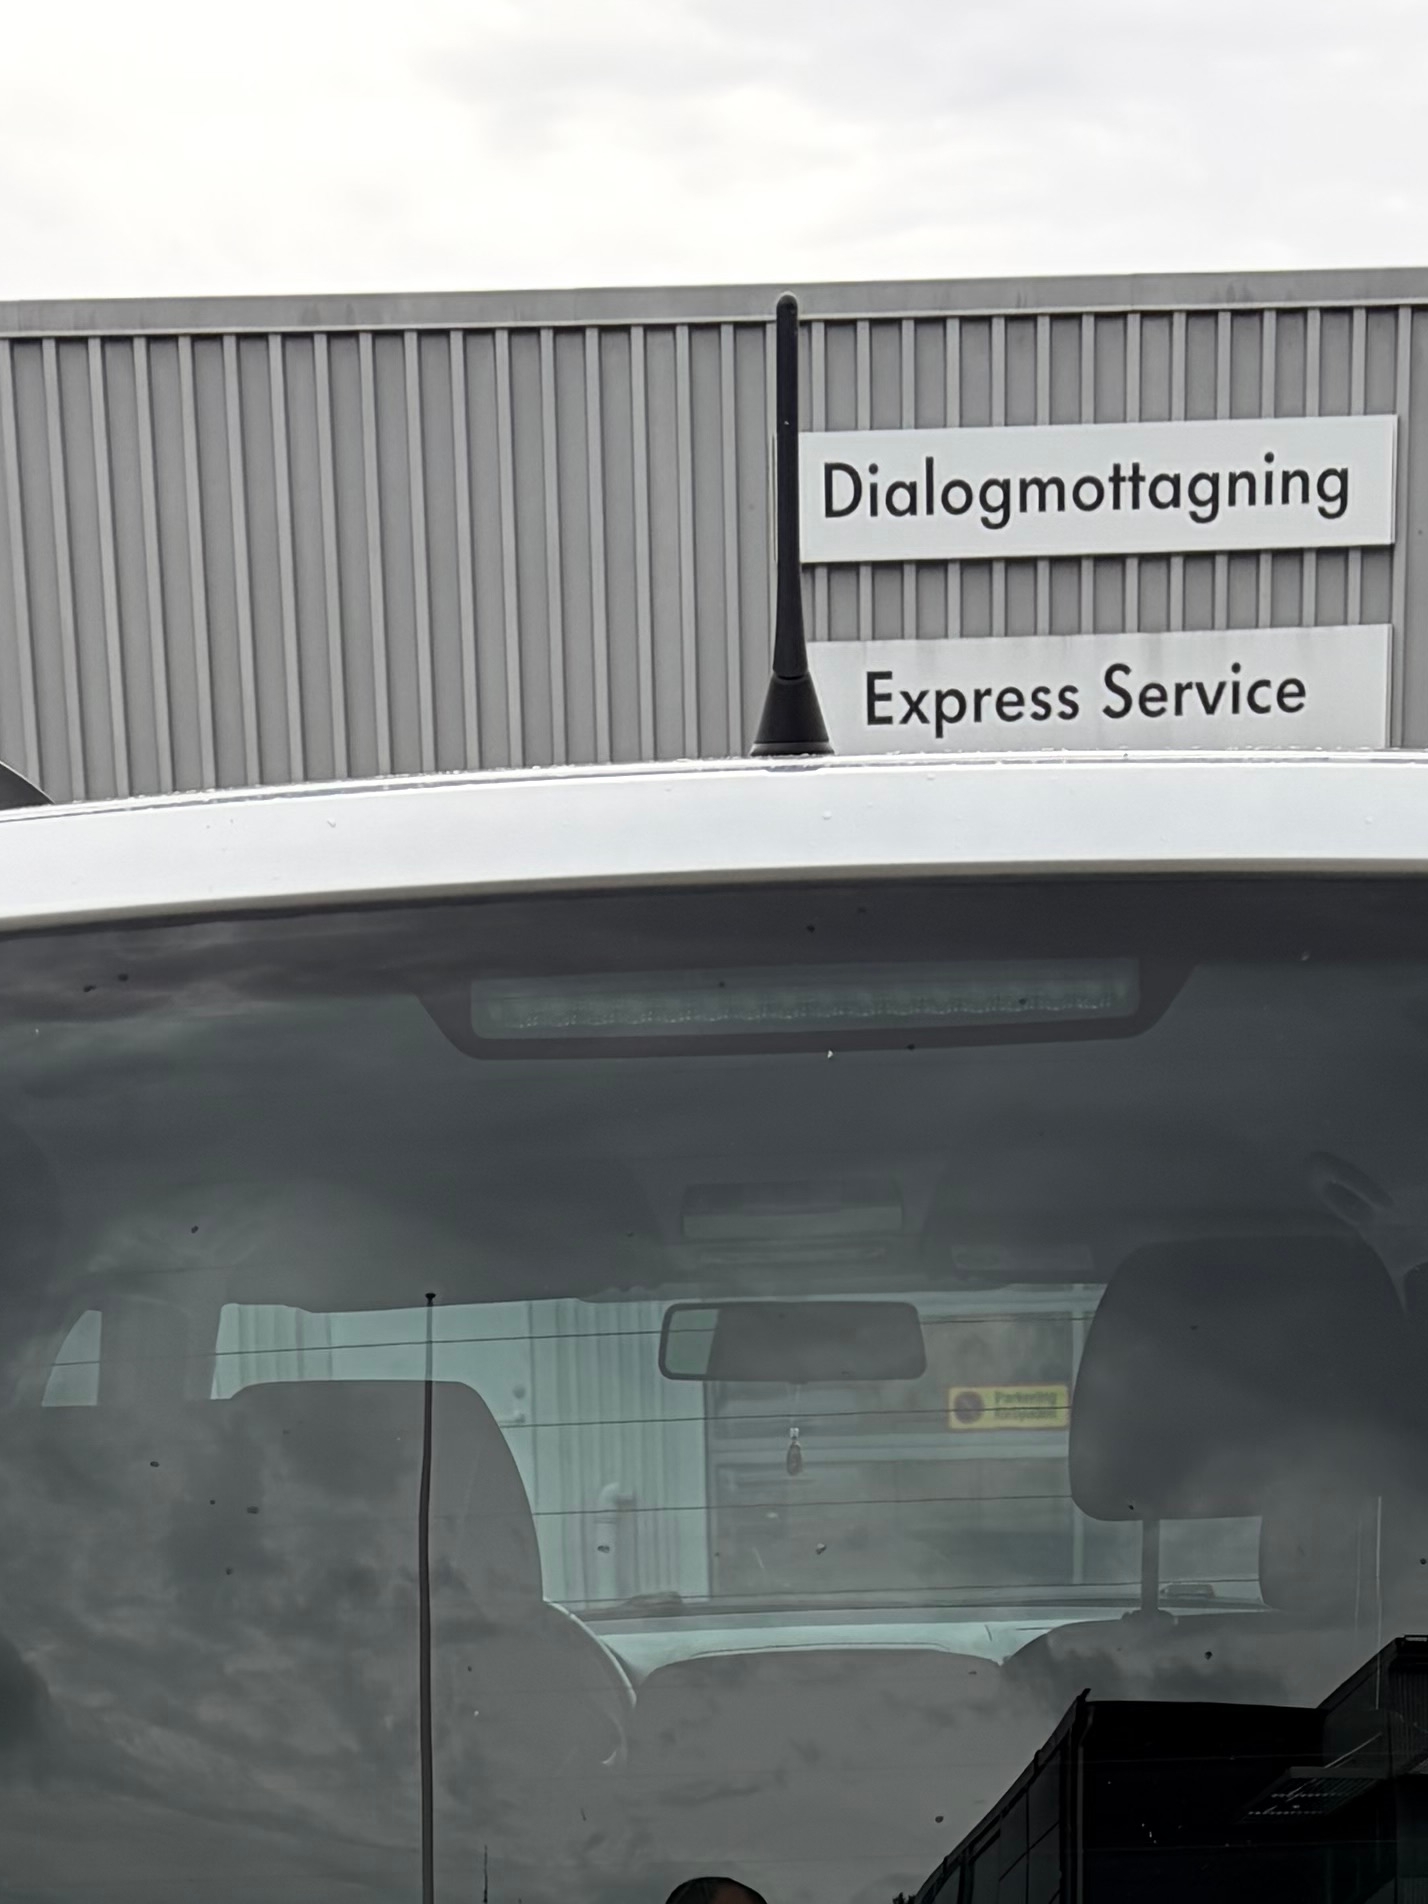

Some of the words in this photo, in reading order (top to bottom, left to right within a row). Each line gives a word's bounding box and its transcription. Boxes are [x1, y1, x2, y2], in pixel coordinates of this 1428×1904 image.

[824, 452, 1349, 530] Dialogmottagning
[866, 671, 1080, 738] Express
[1103, 662, 1307, 719] Service
